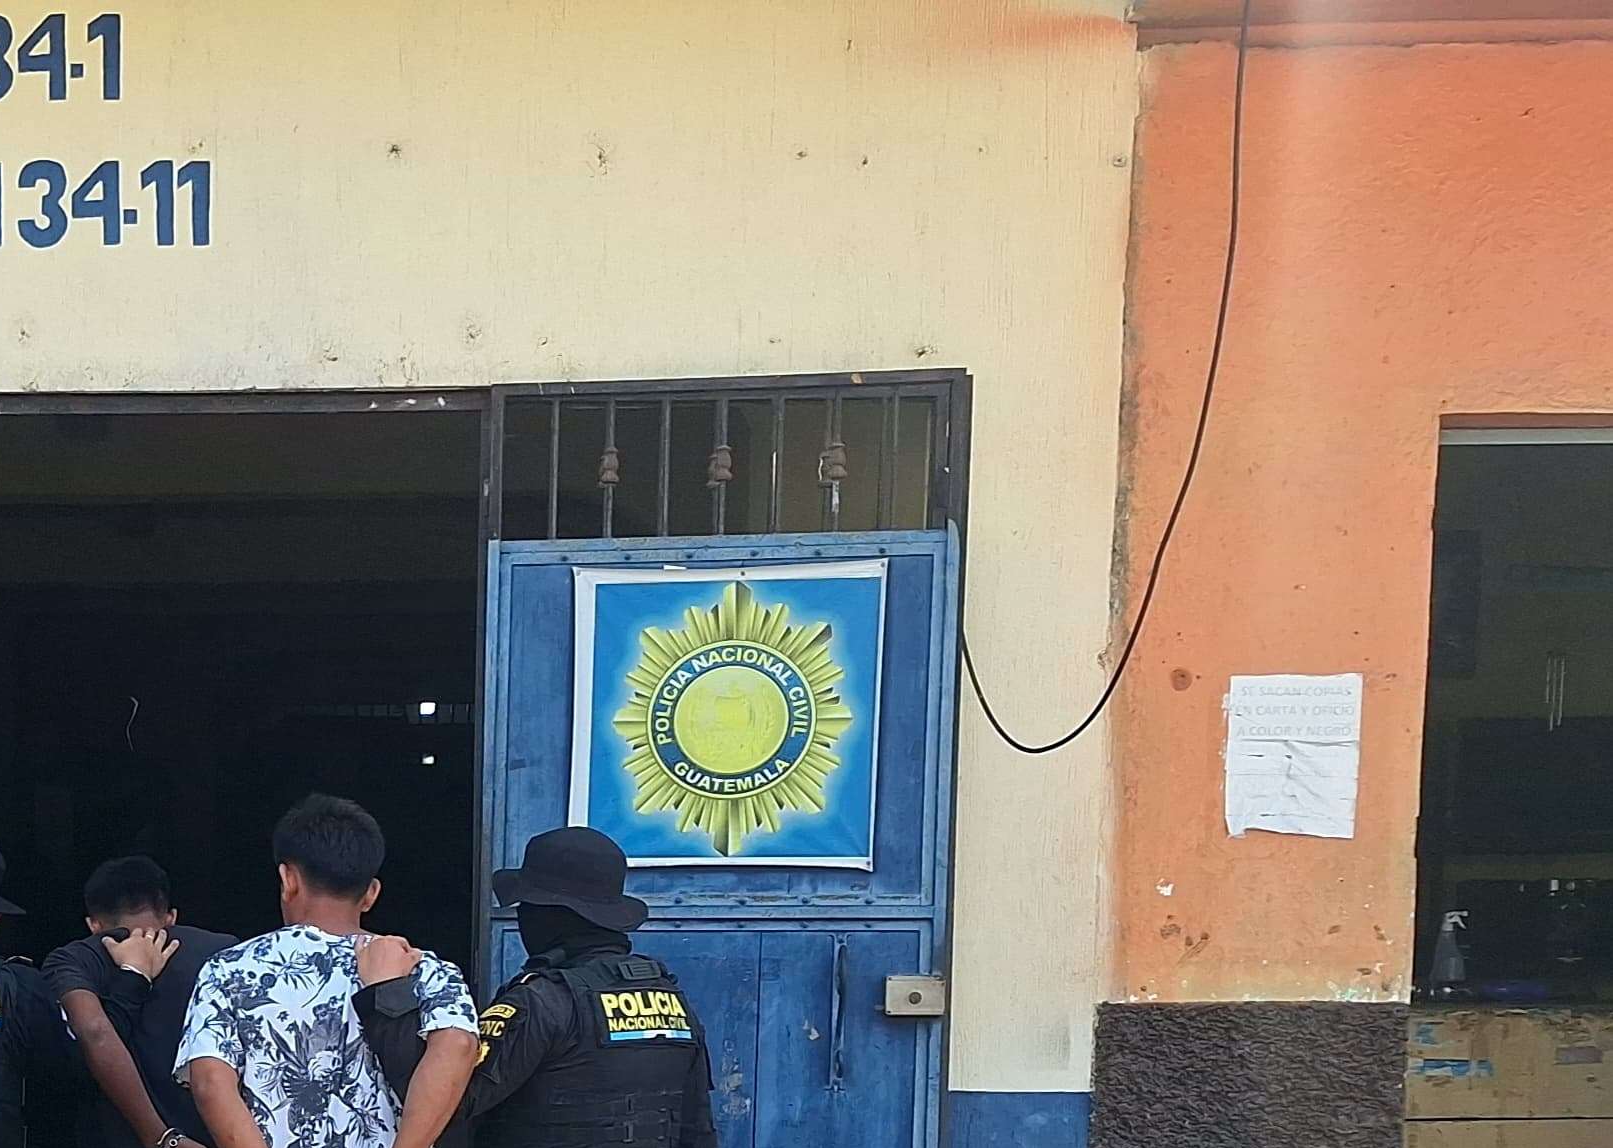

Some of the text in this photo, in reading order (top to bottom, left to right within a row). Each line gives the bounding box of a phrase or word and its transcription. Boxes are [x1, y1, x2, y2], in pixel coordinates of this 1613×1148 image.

[655, 647, 810, 746] POLICIA NACIONAL CIVIL
[673, 757, 791, 793] GUATEMALA
[600, 991, 687, 1018] POLICIA
[608, 1016, 669, 1031] NACIONAL
